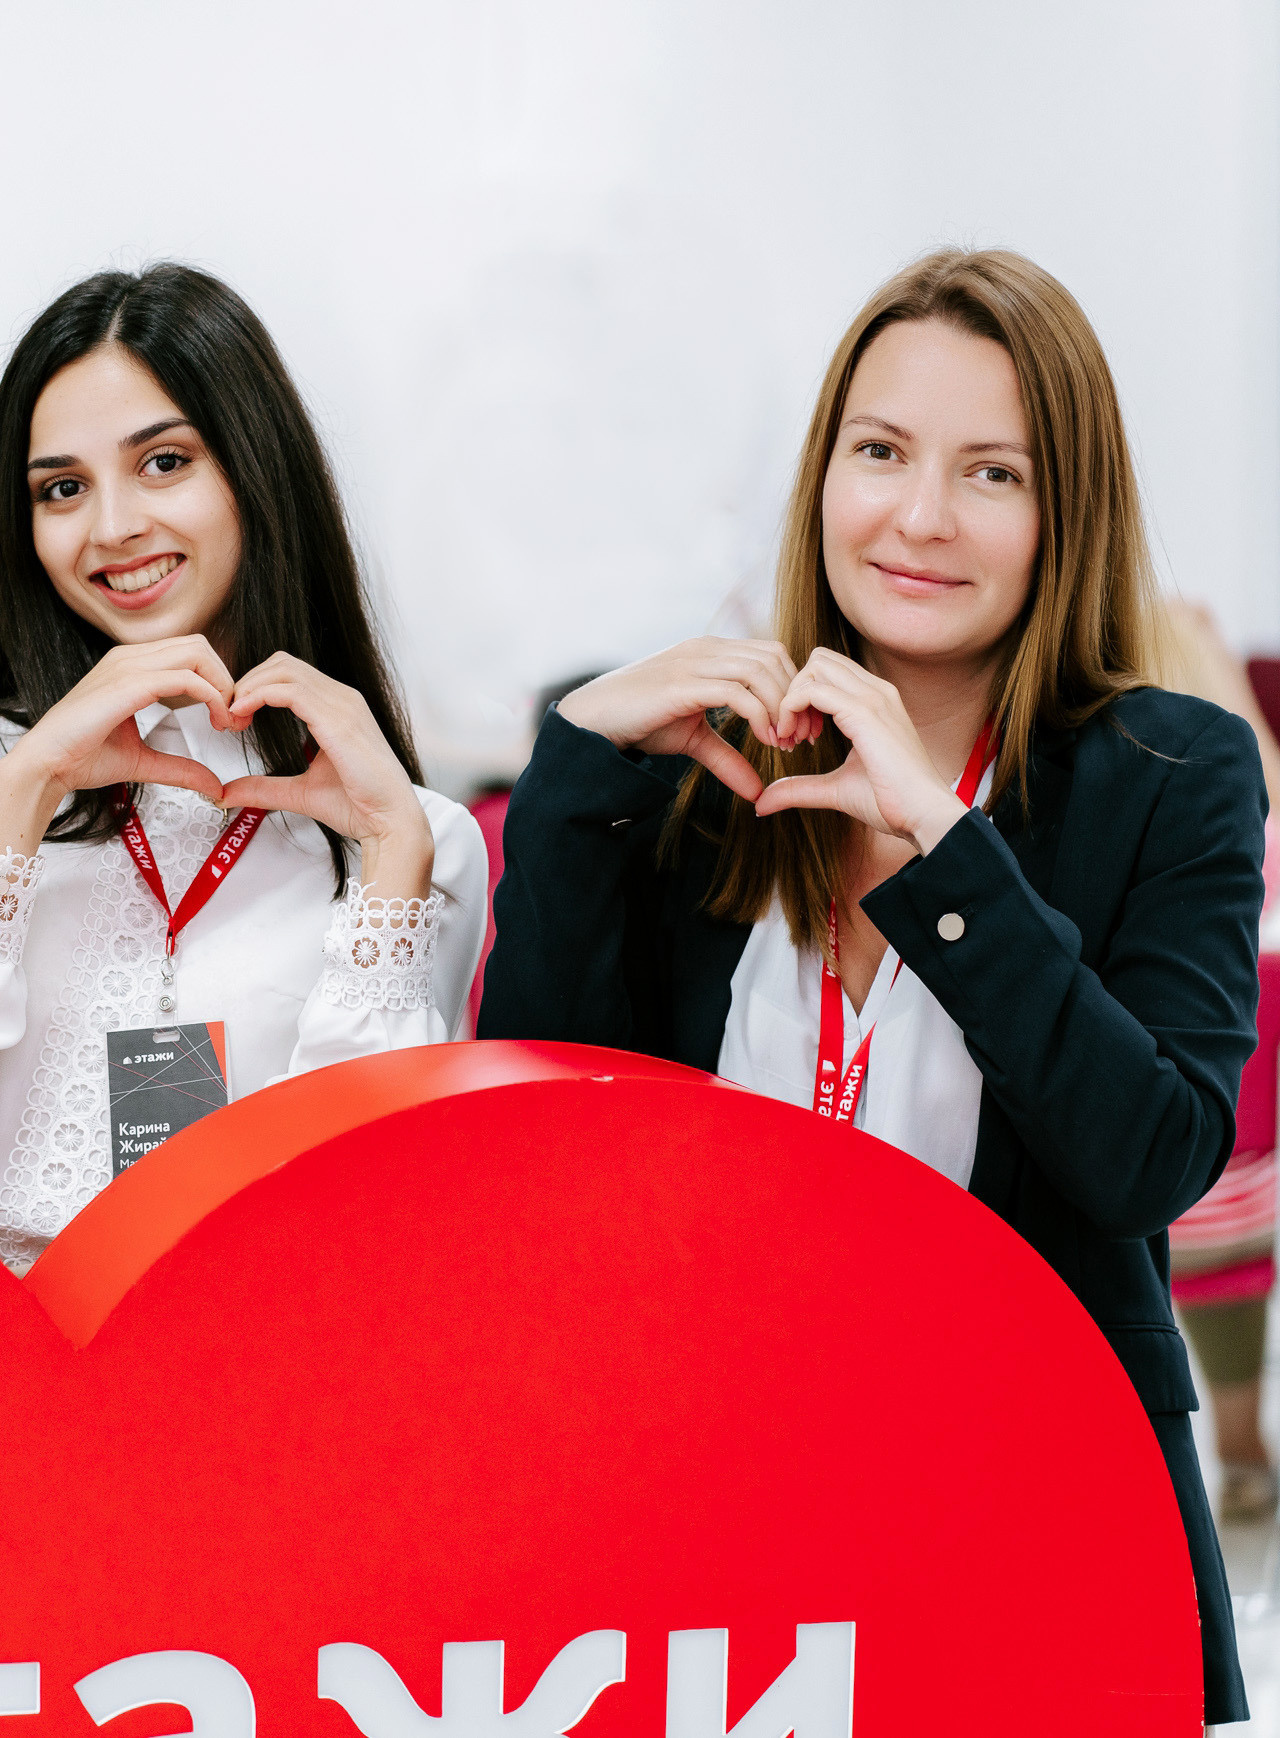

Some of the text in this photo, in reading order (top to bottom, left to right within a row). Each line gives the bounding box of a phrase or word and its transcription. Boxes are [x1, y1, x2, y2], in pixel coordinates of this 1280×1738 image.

[217, 813, 259, 865] этажи
[134, 1051, 175, 1064] этажи
[118, 1122, 171, 1138] Карина
